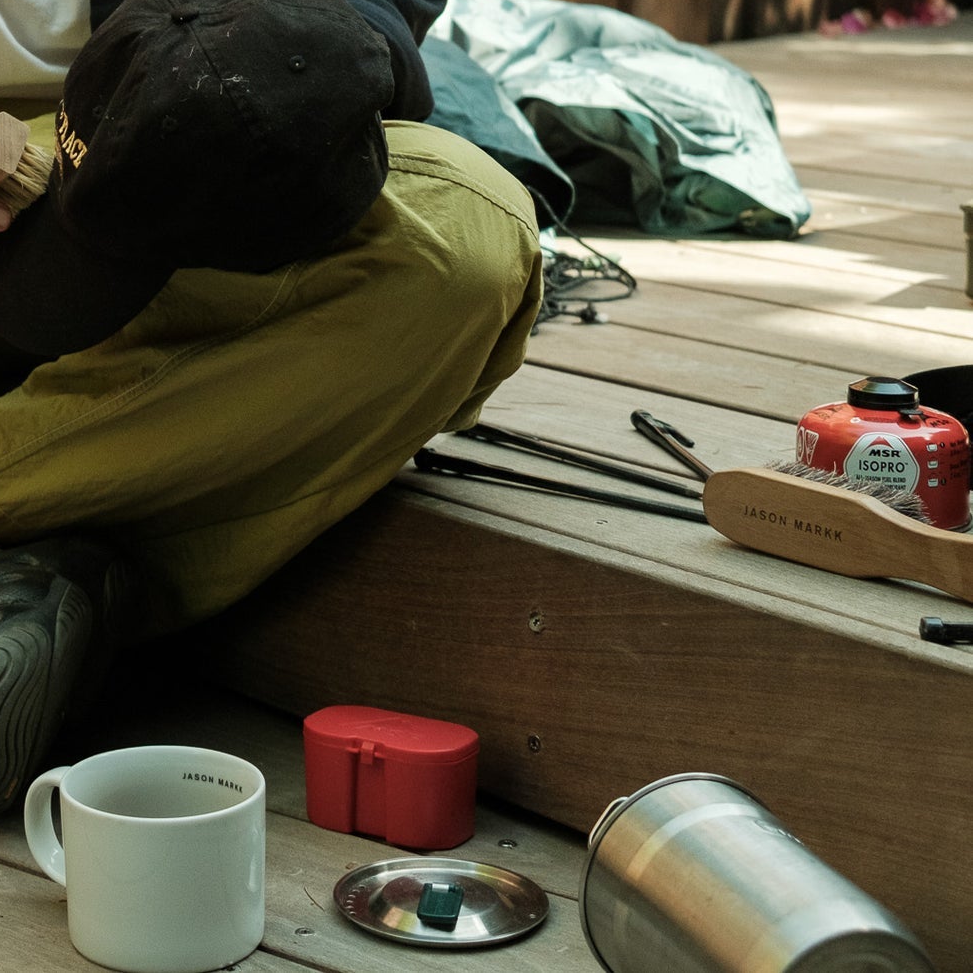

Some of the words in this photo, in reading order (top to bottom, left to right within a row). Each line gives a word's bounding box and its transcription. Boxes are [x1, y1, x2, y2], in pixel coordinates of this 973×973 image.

[58, 99, 88, 168] RACE
[869, 449, 900, 458] MSR
[744, 506, 787, 526] JASON
[794, 519, 842, 543] MARKK
[182, 773, 214, 783] JASON
[218, 778, 243, 794] MARKK
